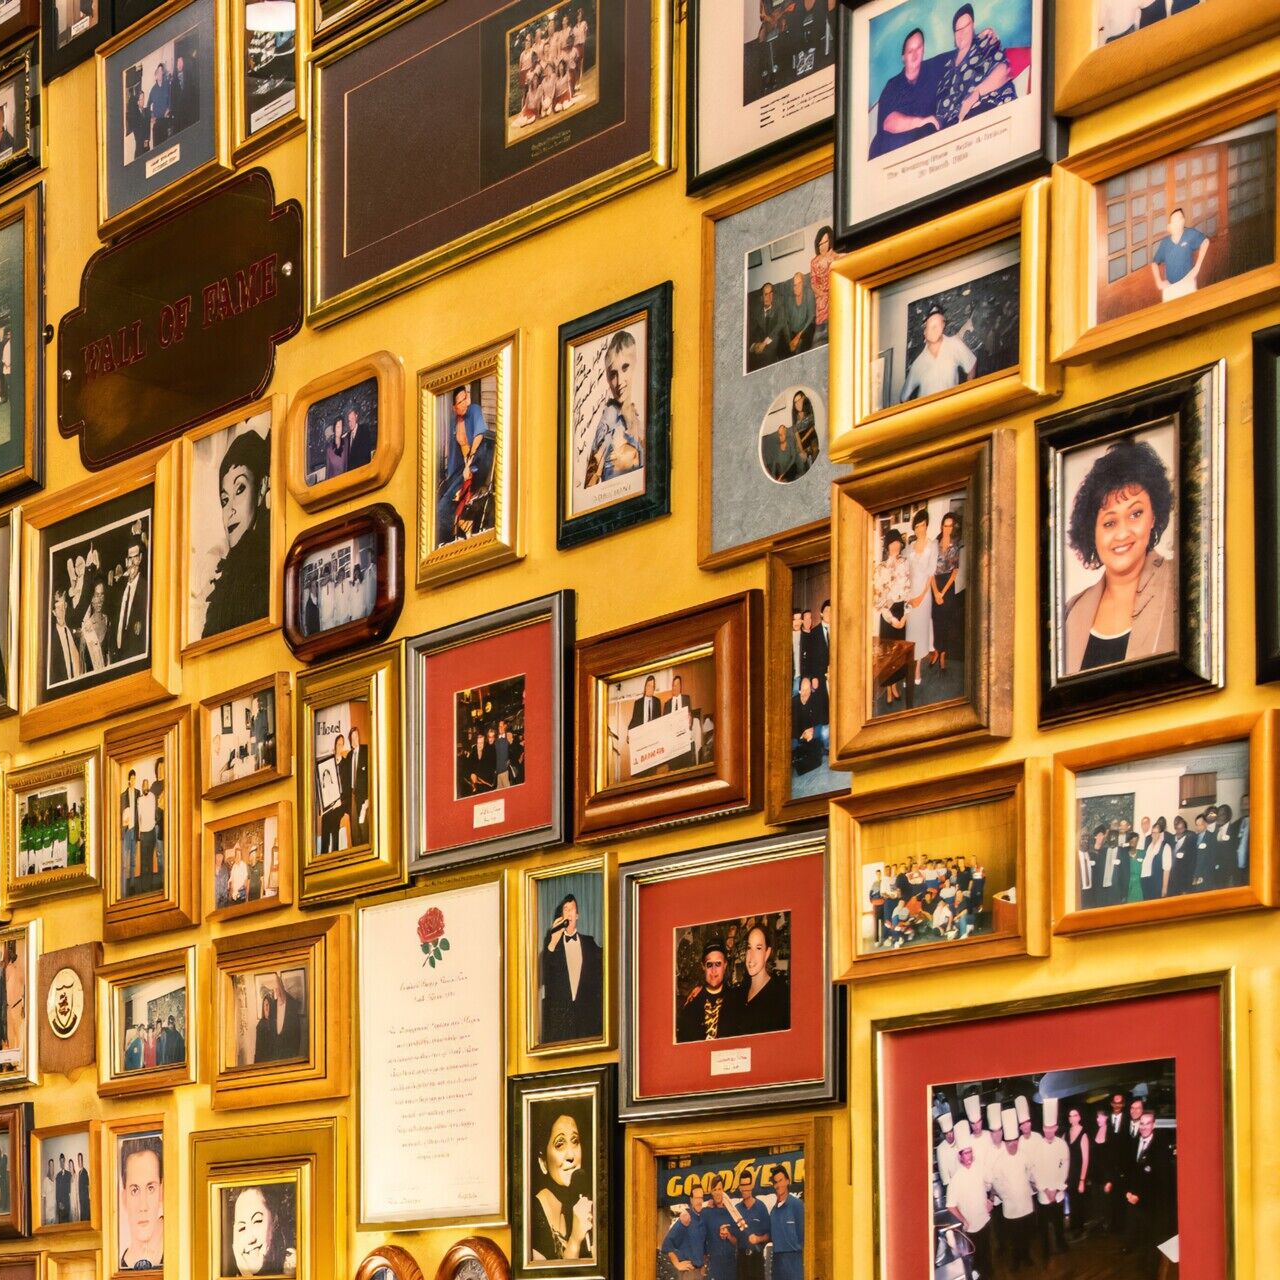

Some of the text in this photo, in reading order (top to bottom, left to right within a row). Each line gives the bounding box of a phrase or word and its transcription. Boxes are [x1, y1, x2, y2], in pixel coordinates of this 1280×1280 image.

[81, 253, 277, 381] WALL OF FAME
